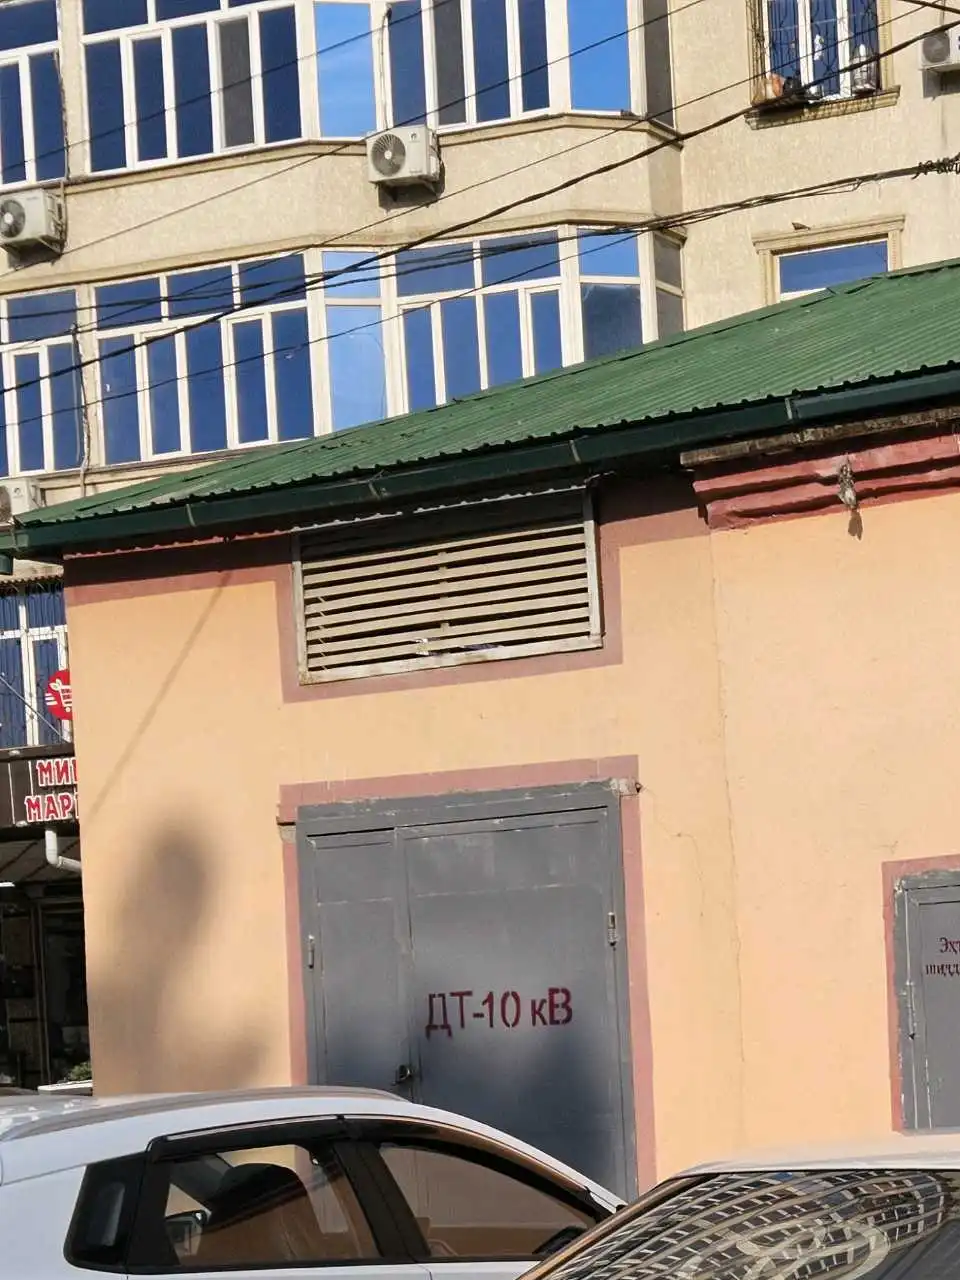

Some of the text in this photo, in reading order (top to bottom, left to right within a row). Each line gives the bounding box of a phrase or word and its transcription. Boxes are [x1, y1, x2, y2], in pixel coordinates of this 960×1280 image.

[24, 792, 79, 822] МАР
[425, 987, 573, 1040] ДТ-10 кВ
